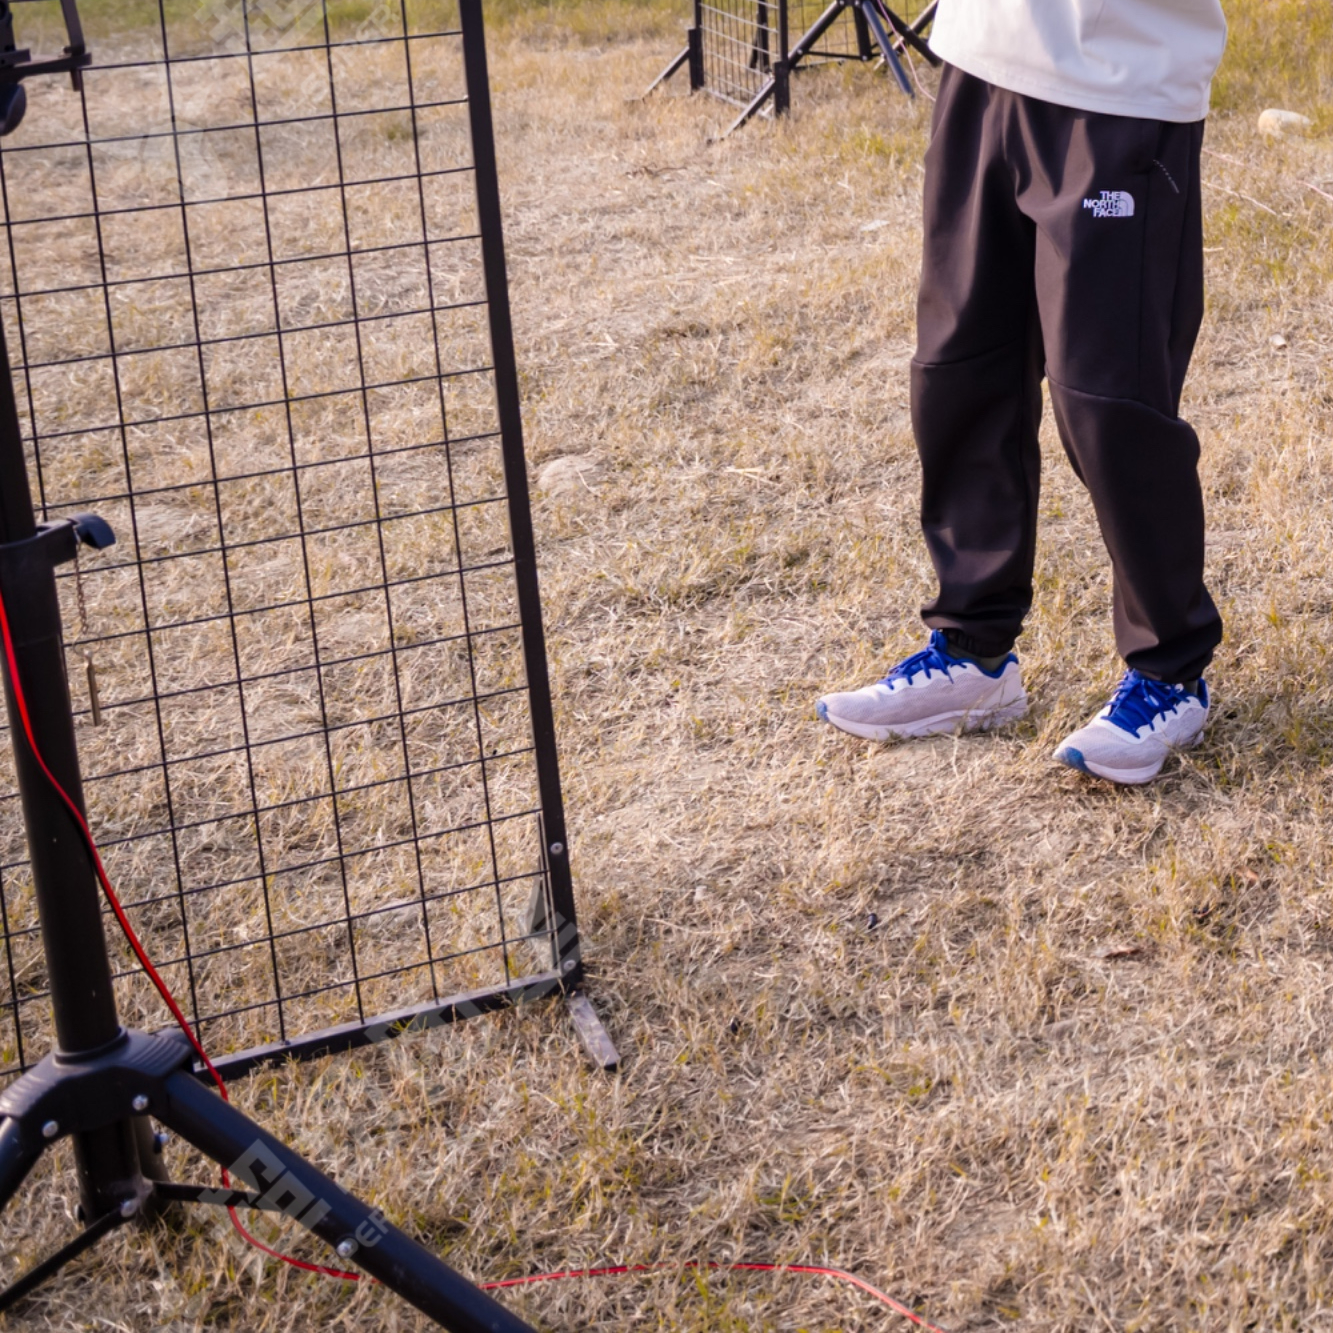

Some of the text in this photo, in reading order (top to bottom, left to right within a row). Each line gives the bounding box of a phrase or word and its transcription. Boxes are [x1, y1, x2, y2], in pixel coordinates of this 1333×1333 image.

[1100, 191, 1120, 200] THE
[1083, 199, 1120, 209] NORTH
[1093, 208, 1120, 217] FACE
